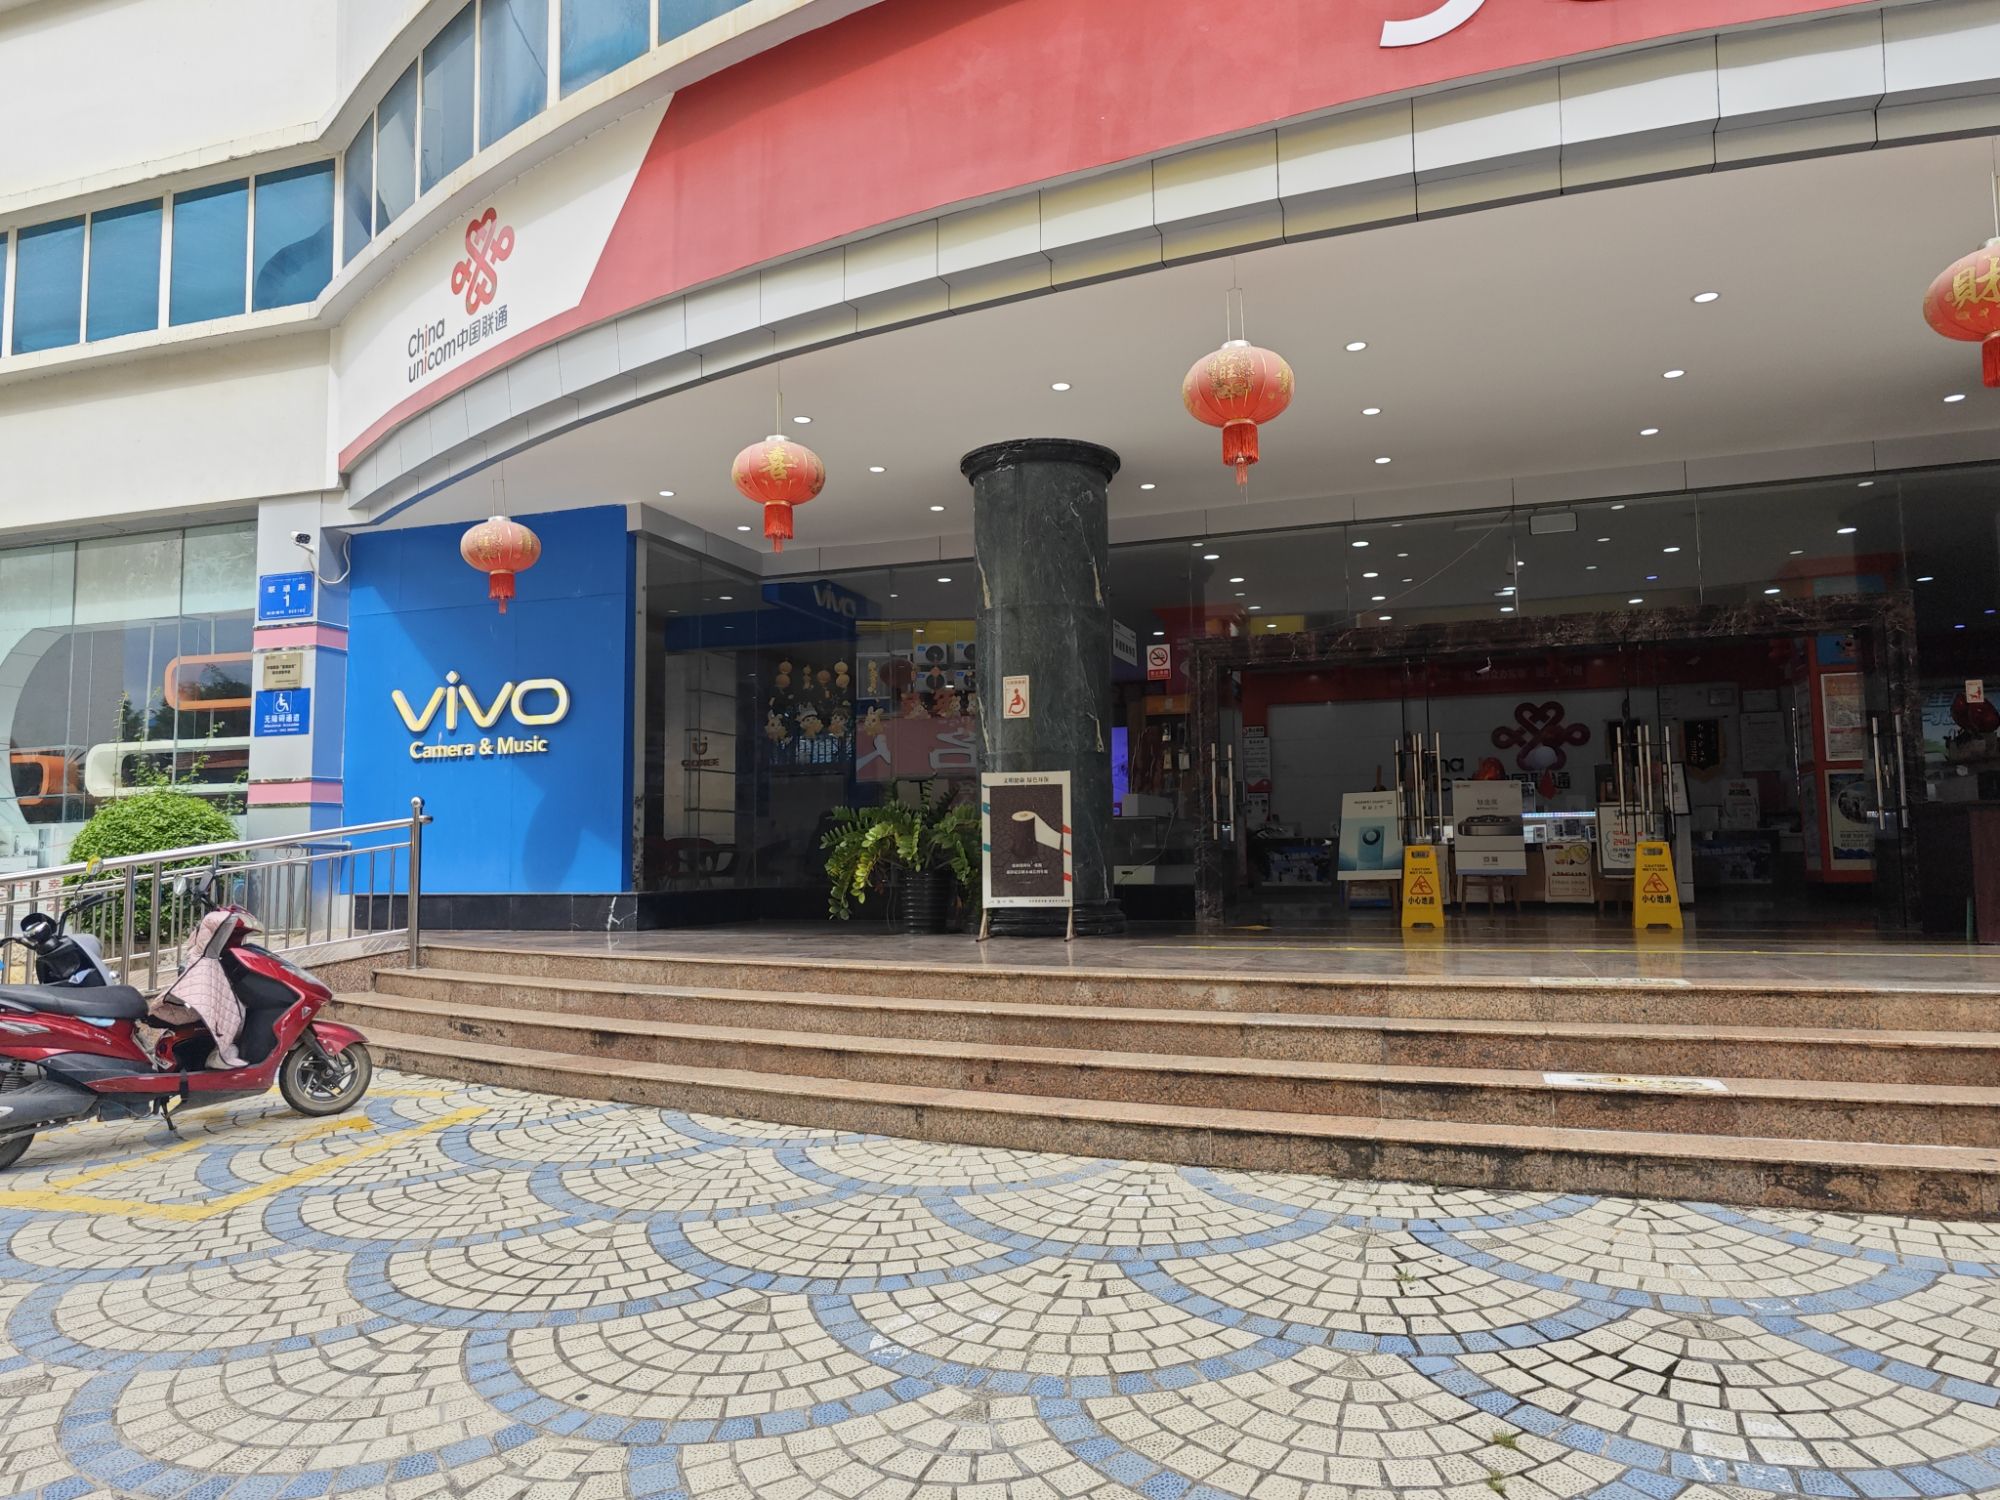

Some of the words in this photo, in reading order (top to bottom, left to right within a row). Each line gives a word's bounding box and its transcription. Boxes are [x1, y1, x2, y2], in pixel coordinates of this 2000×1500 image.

[408, 319, 445, 356] China
[456, 305, 508, 351] 中国联通
[408, 339, 456, 383] unicom
[391, 670, 571, 732] vivo
[409, 740, 476, 759] Camera
[478, 737, 494, 755] &
[497, 735, 549, 755] Music
